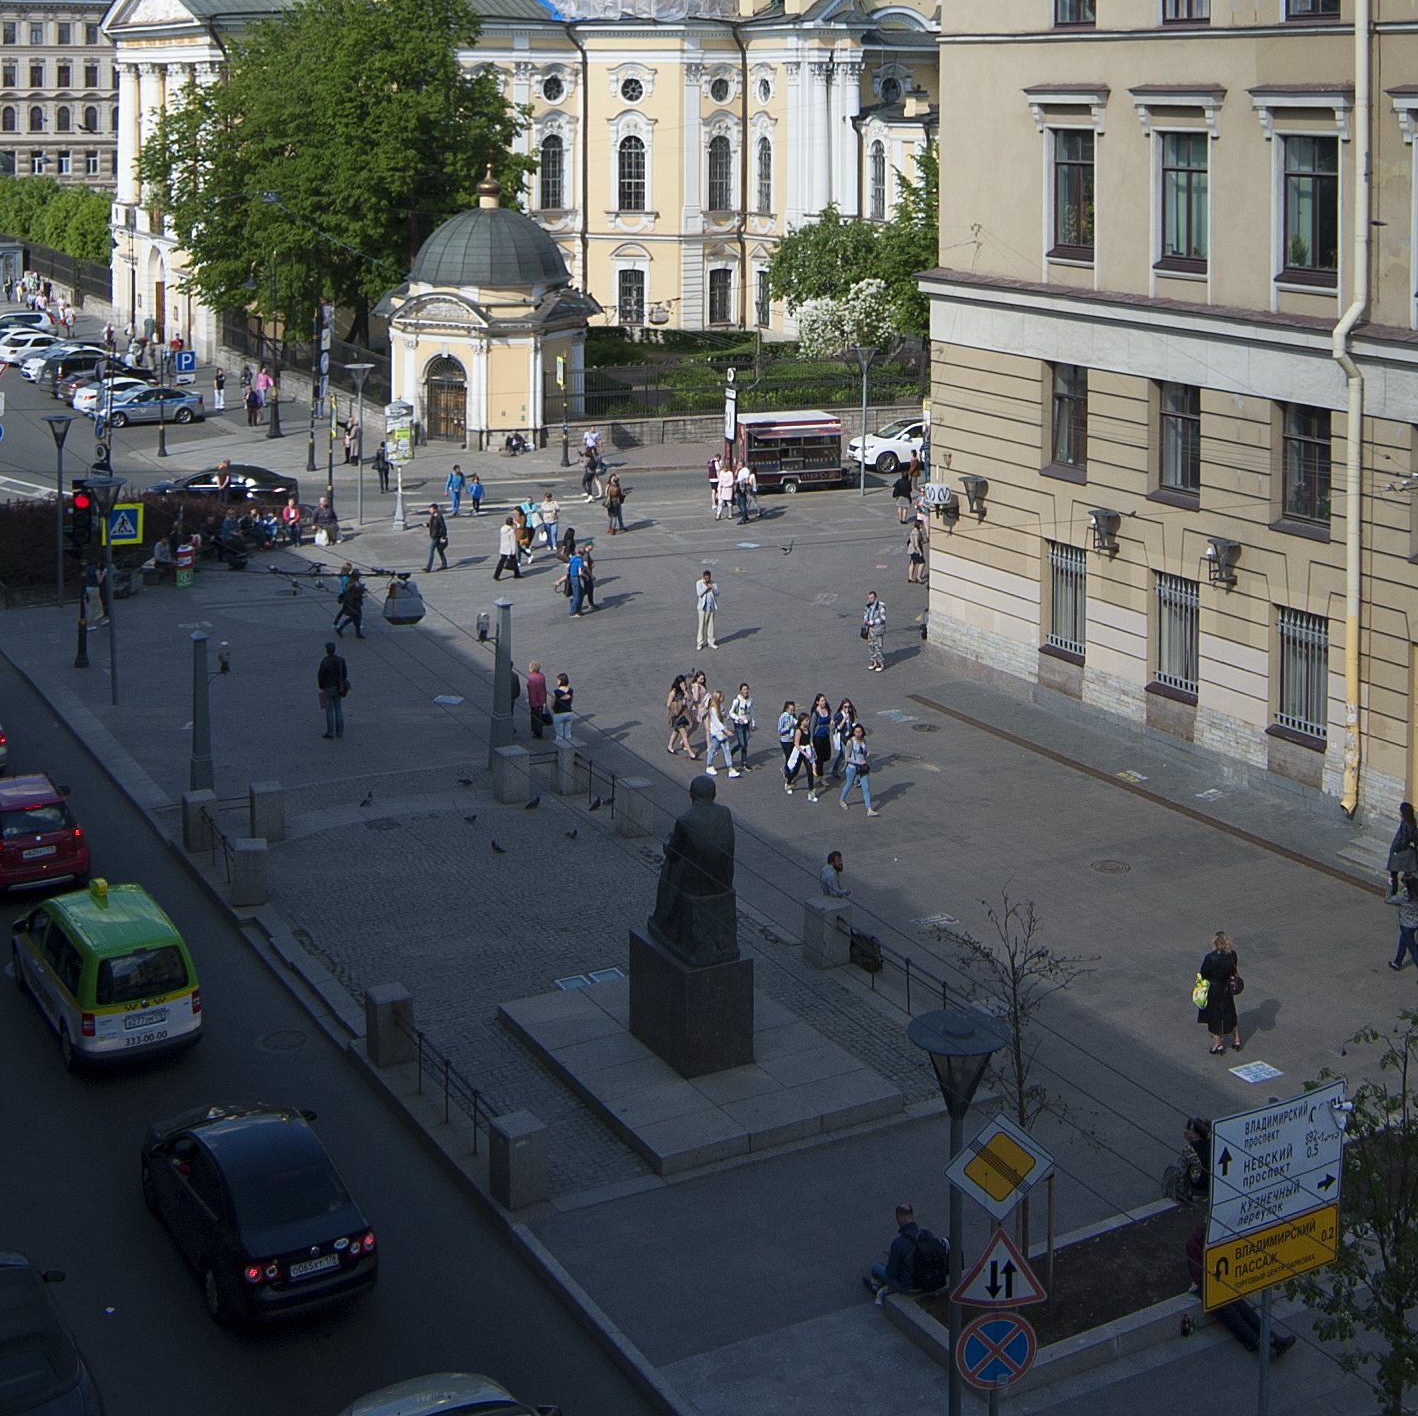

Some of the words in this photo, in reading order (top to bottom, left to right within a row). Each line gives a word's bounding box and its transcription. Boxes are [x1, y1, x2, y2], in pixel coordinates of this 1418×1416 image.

[182, 353, 192, 370] P
[1244, 1102, 1308, 1135] ВЛАДИМИРСКИЙ
[1244, 1129, 1280, 1150] проспект
[1243, 1143, 1293, 1173] НЕВСКИЙ
[1242, 1162, 1290, 1188] проспект
[1240, 1179, 1301, 1214] КУЗНЕЧНЫЙ
[1238, 1202, 1284, 1226] переулок
[1235, 1219, 1316, 1260] ВЛАДИМИРСКИЙ
[1235, 1250, 1278, 1278] ПАССАЖ
